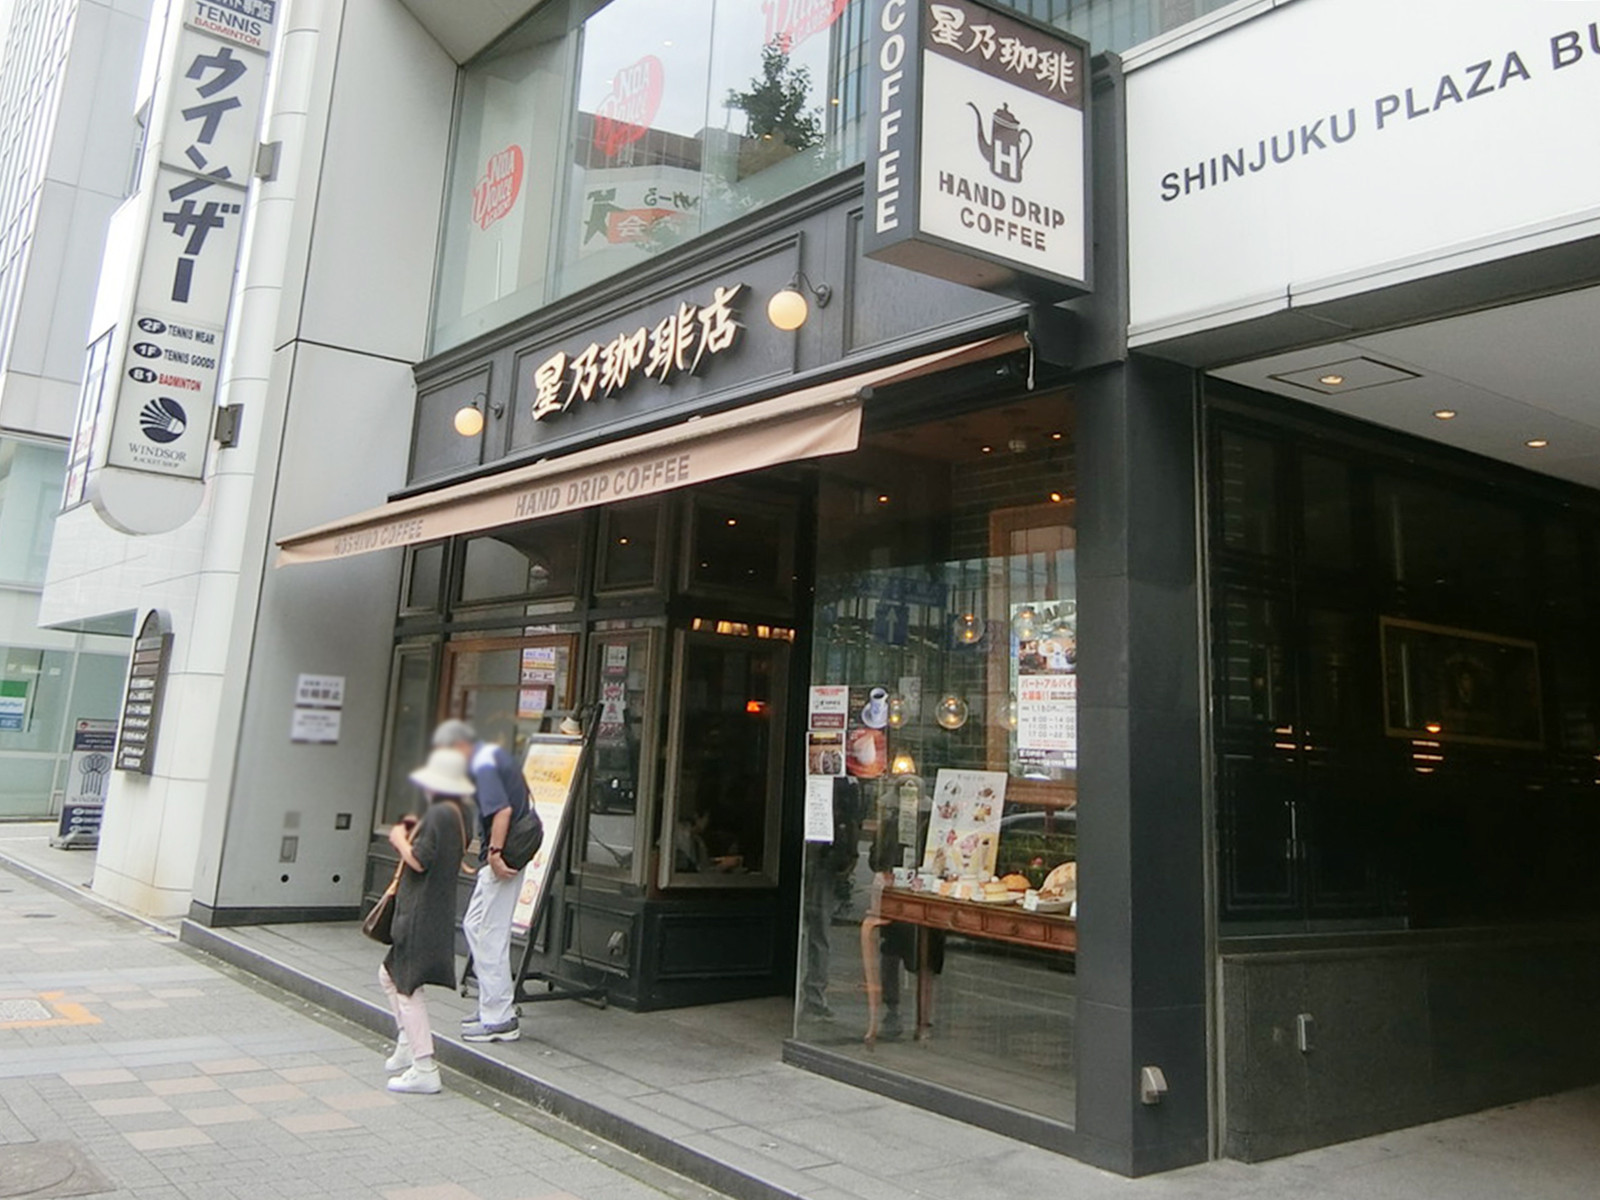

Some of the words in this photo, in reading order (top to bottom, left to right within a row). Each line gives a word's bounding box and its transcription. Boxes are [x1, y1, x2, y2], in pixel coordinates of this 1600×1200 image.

[194, 16, 261, 46] BADMINTON
[196, 1, 262, 37] TENNIS
[929, 3, 1075, 94] 星乃珈琲
[876, 0, 906, 234] COFFEE
[1160, 107, 1357, 203] SHINJUKU
[1374, 50, 1532, 131] PLAZA
[939, 171, 1006, 212] HAND
[1012, 196, 1066, 230] DRIP
[959, 207, 1047, 252] COFFEE
[142, 319, 163, 333] 2F
[168, 324, 194, 340] TENNIS
[195, 330, 215, 345] WEAR
[531, 282, 745, 422] 星乃珈琲店
[138, 343, 158, 357] 1F
[164, 349, 190, 365] TENNIS
[191, 354, 216, 370] GOODS
[158, 373, 202, 391] BADMINTON
[128, 442, 187, 462] WINDSOR
[514, 484, 561, 519] HAND
[566, 473, 609, 507] DRIP
[613, 454, 691, 495] COFFEE
